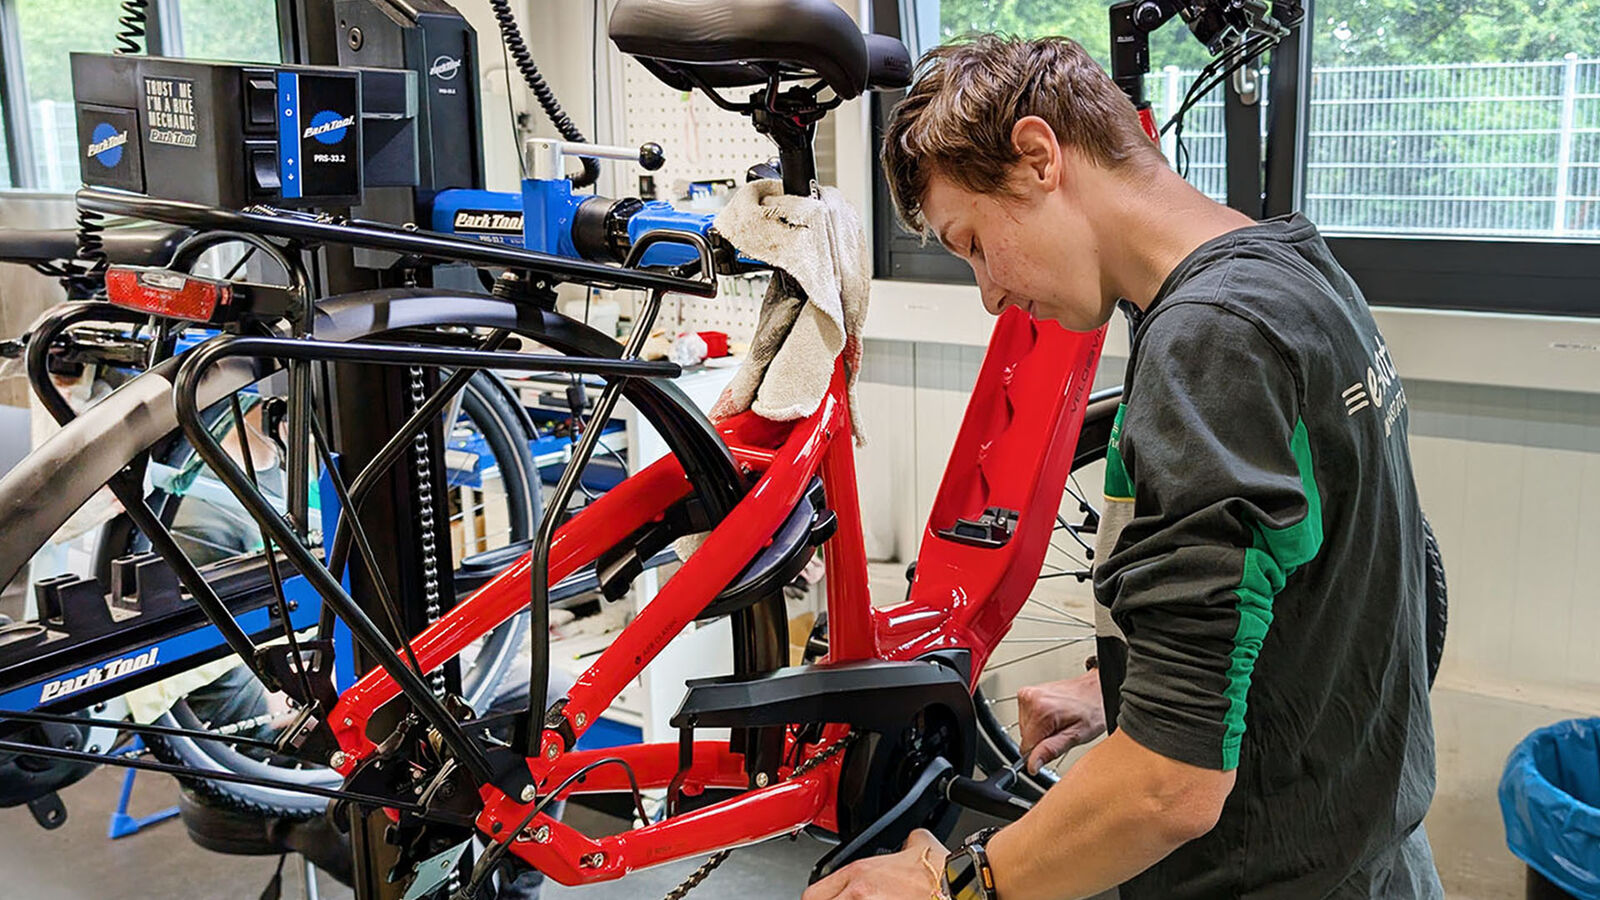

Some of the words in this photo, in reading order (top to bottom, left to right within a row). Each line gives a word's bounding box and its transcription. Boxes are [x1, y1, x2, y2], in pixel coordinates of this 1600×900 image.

[145, 80, 173, 97] TRUST
[179, 83, 192, 98] ME
[147, 96, 161, 111] I'M
[164, 97, 171, 112] A
[173, 98, 194, 114] BIKE
[148, 111, 195, 130] MECHANIC
[313, 154, 346, 163] PRS-33.2
